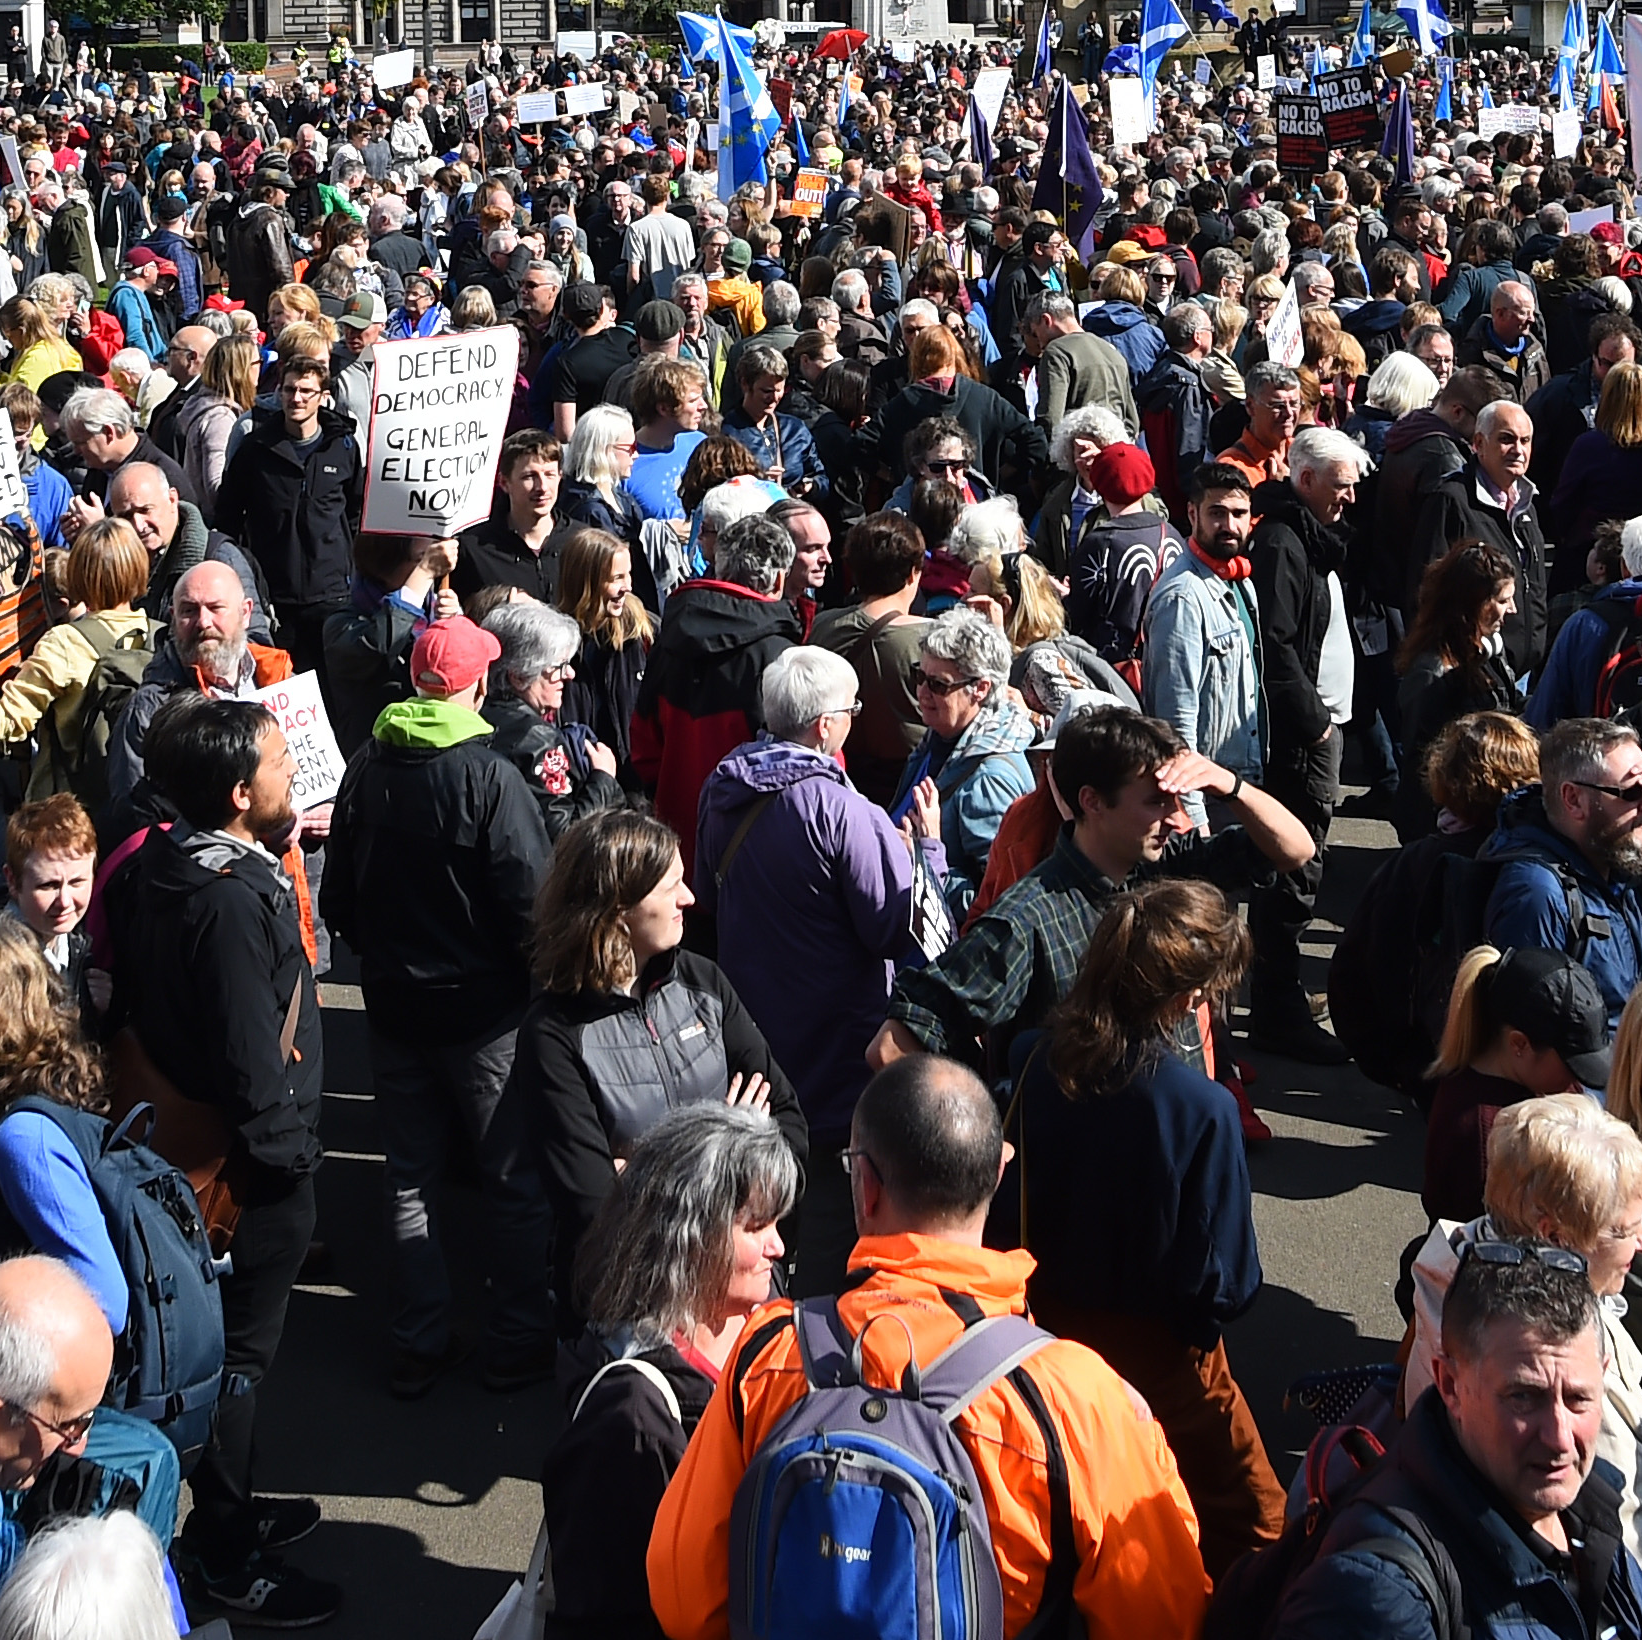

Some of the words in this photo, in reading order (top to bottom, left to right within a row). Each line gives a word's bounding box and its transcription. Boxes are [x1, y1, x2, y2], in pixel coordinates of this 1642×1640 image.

[781, 23, 820, 33] POLIC
[1317, 81, 1339, 99] NO
[1342, 77, 1362, 93] TO
[1320, 89, 1374, 114] RACISM
[1278, 104, 1299, 120] NO
[1302, 105, 1320, 121] TO
[794, 187, 824, 204] OUT!
[398, 343, 497, 382] DEFEND
[374, 377, 504, 415] DEMOCRACY.
[386, 420, 488, 452] GENERAL
[380, 445, 490, 483] ELECTION
[408, 478, 473, 511] NOW!
[284, 703, 317, 733] ACY
[297, 749, 329, 775] ENT
[292, 768, 337, 796] OWN
